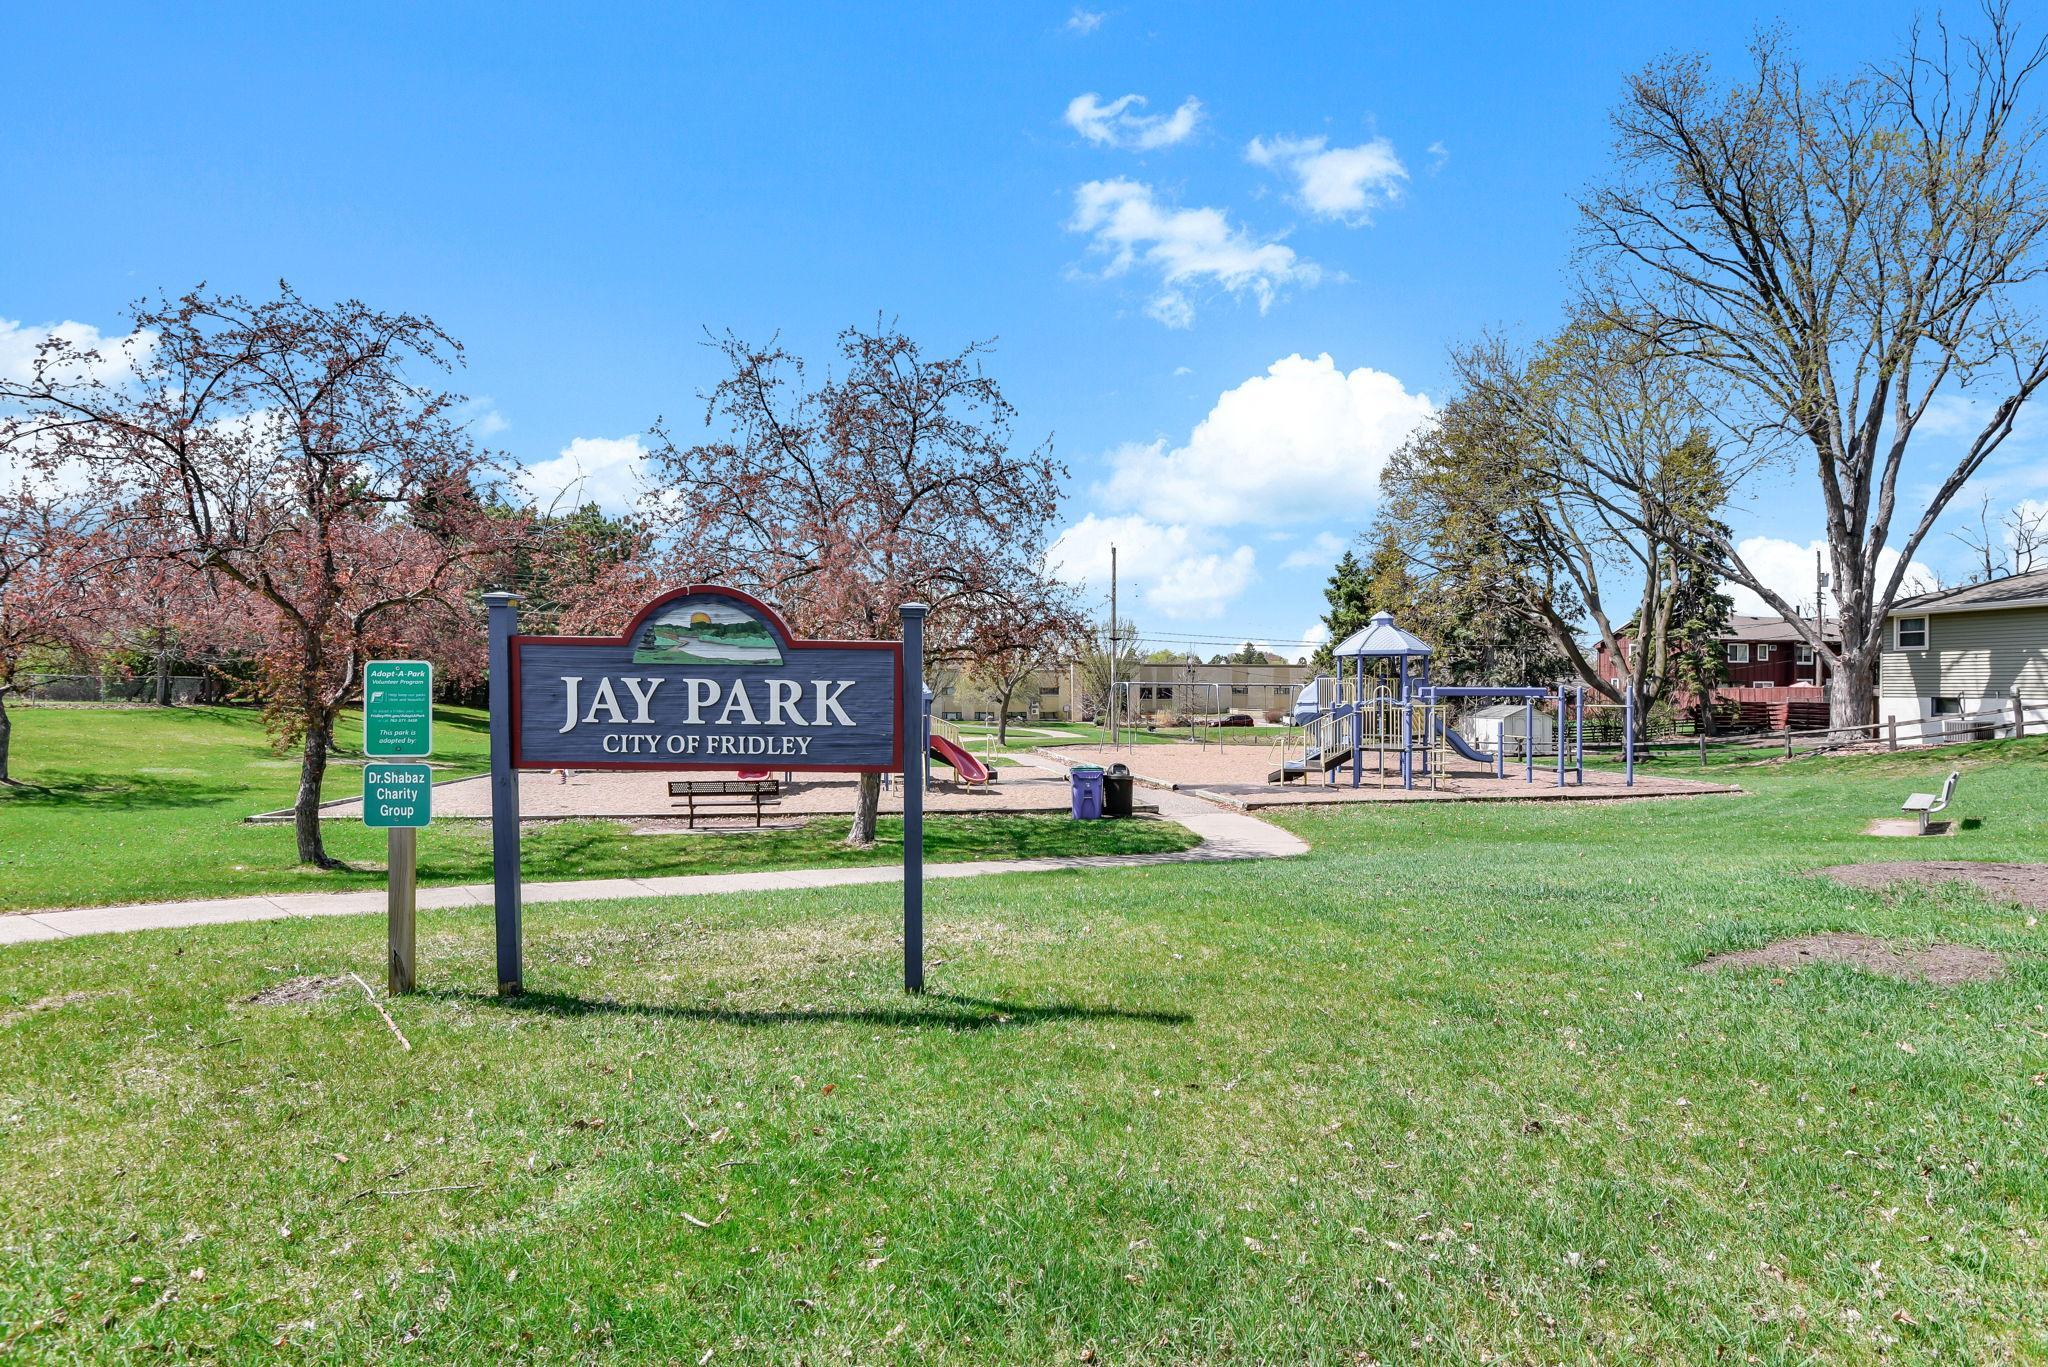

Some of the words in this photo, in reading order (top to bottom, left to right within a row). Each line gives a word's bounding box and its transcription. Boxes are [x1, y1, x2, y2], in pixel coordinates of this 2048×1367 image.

[371, 670, 425, 678] Adopt-A-Park
[559, 676, 666, 734] JAY
[682, 677, 857, 727] PARK
[379, 737, 404, 745] adopted
[602, 734, 662, 754] CITY
[666, 734, 700, 754] OF
[706, 734, 813, 755] FRIDLEY
[368, 772, 425, 784] Dr.Shabaz
[376, 788, 418, 802] Charity
[380, 804, 414, 818] Group
